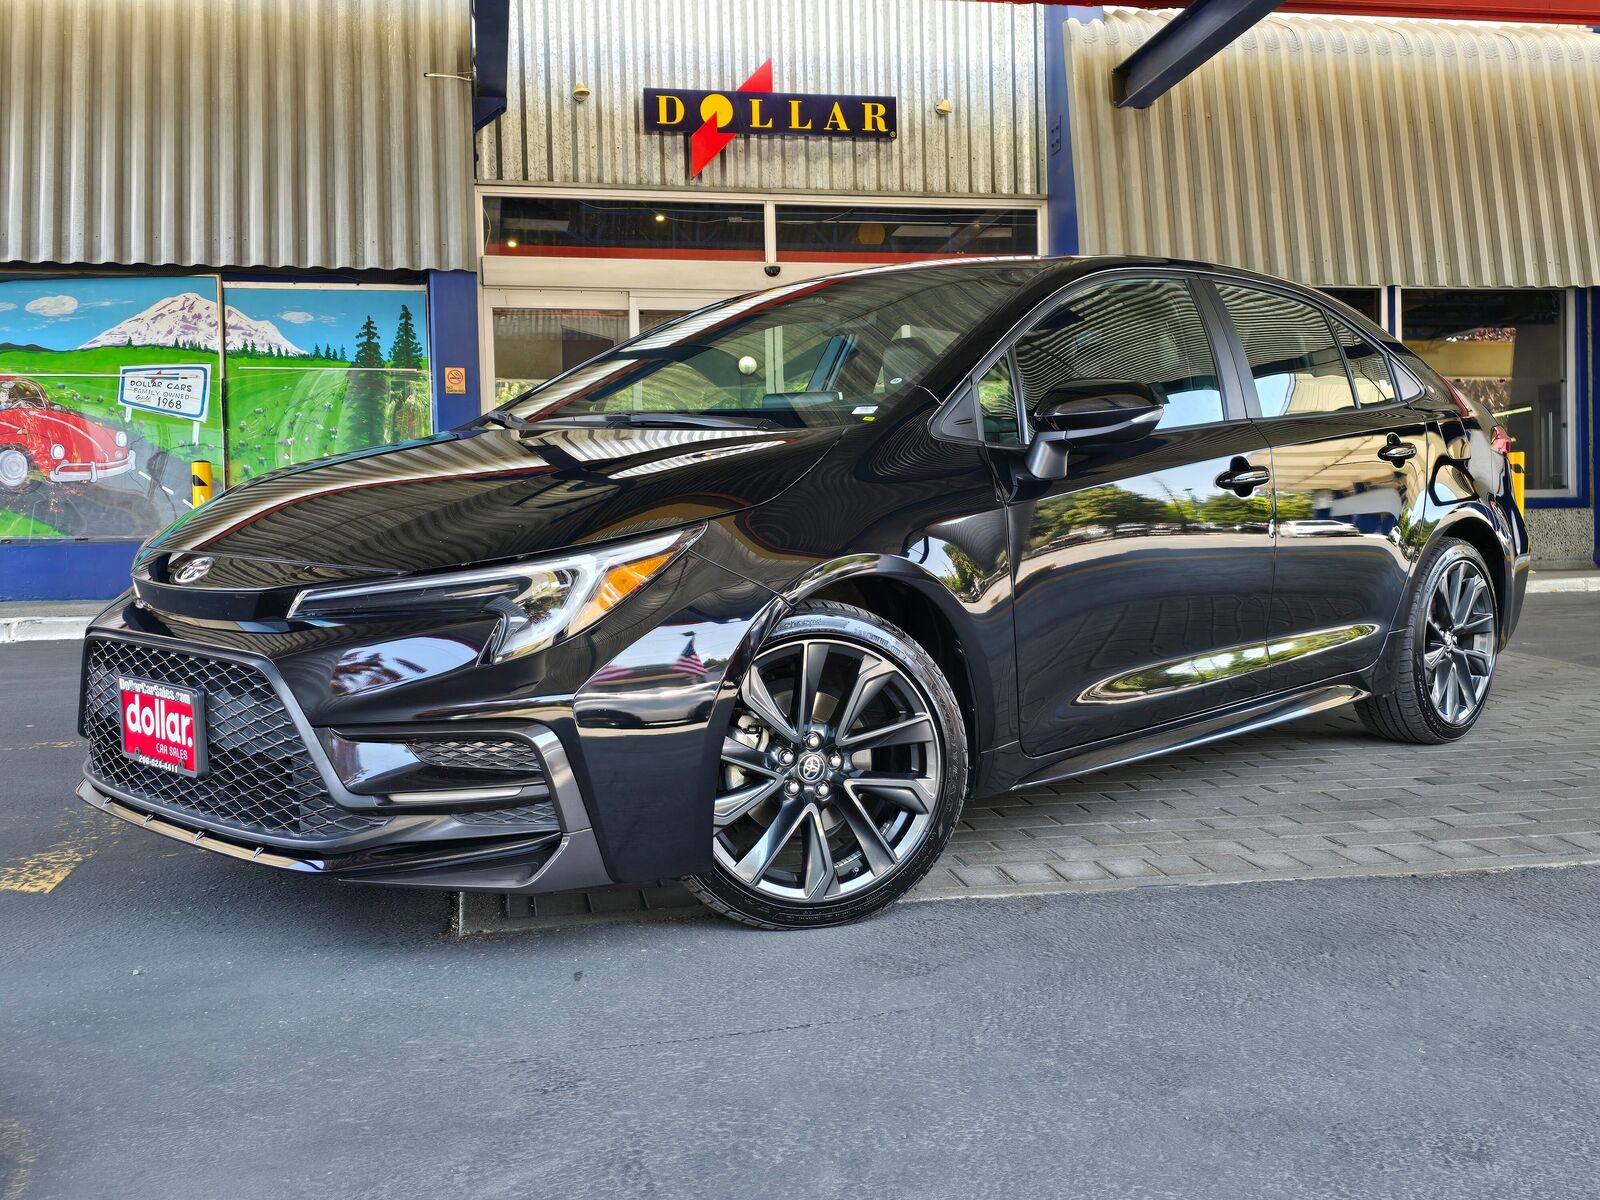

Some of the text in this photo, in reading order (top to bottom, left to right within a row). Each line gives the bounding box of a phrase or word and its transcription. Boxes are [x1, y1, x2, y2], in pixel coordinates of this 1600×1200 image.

[655, 93, 889, 132] DOLLAR
[130, 380, 192, 392] DOLLAR CARS
[133, 388, 190, 400] FAMILY OWNED
[157, 396, 182, 410] 1968
[155, 742, 188, 760] CAR SALES
